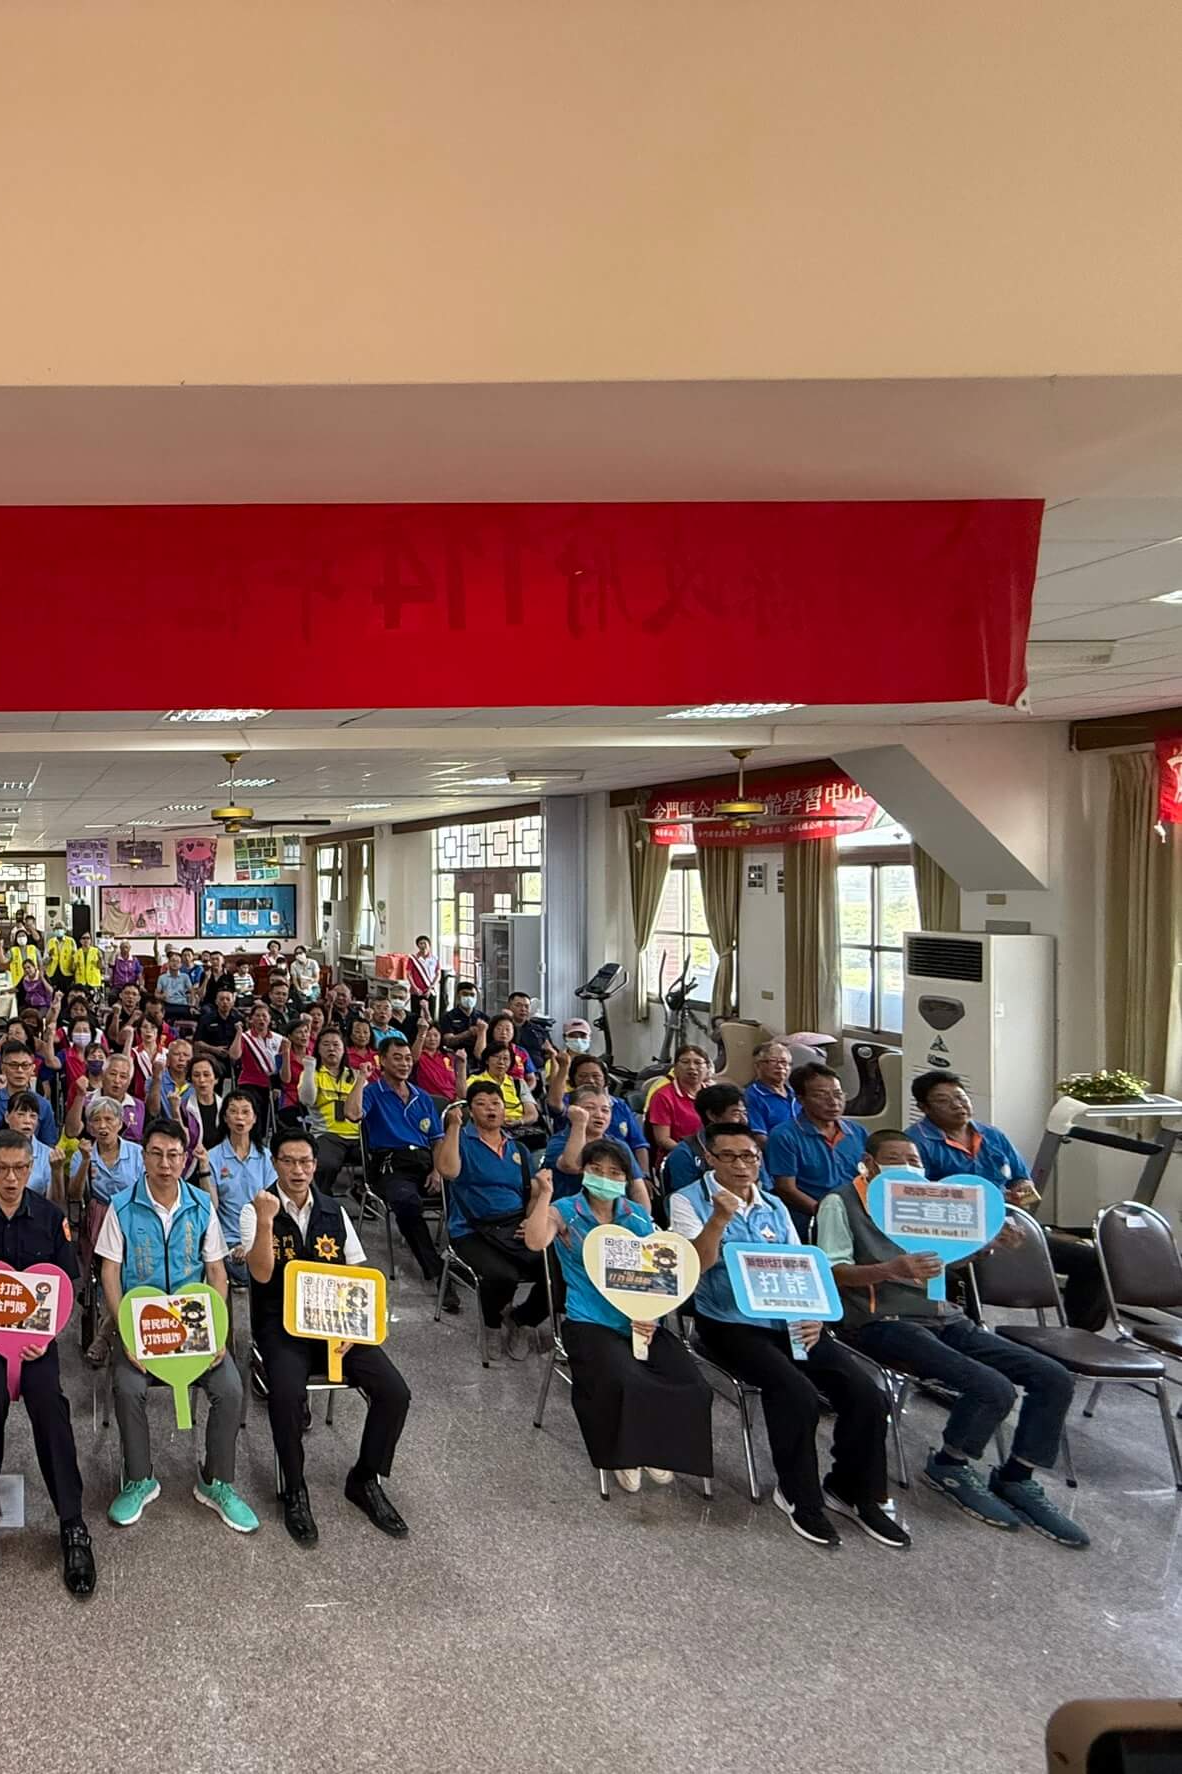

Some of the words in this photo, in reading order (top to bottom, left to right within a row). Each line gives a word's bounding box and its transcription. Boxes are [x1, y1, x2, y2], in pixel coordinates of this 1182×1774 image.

[895, 1202, 974, 1224] 三查證
[901, 1225, 929, 1235] Check
[932, 1228, 938, 1236] it
[0, 1282, 23, 1296] 打詐
[758, 1272, 808, 1295] 打詐
